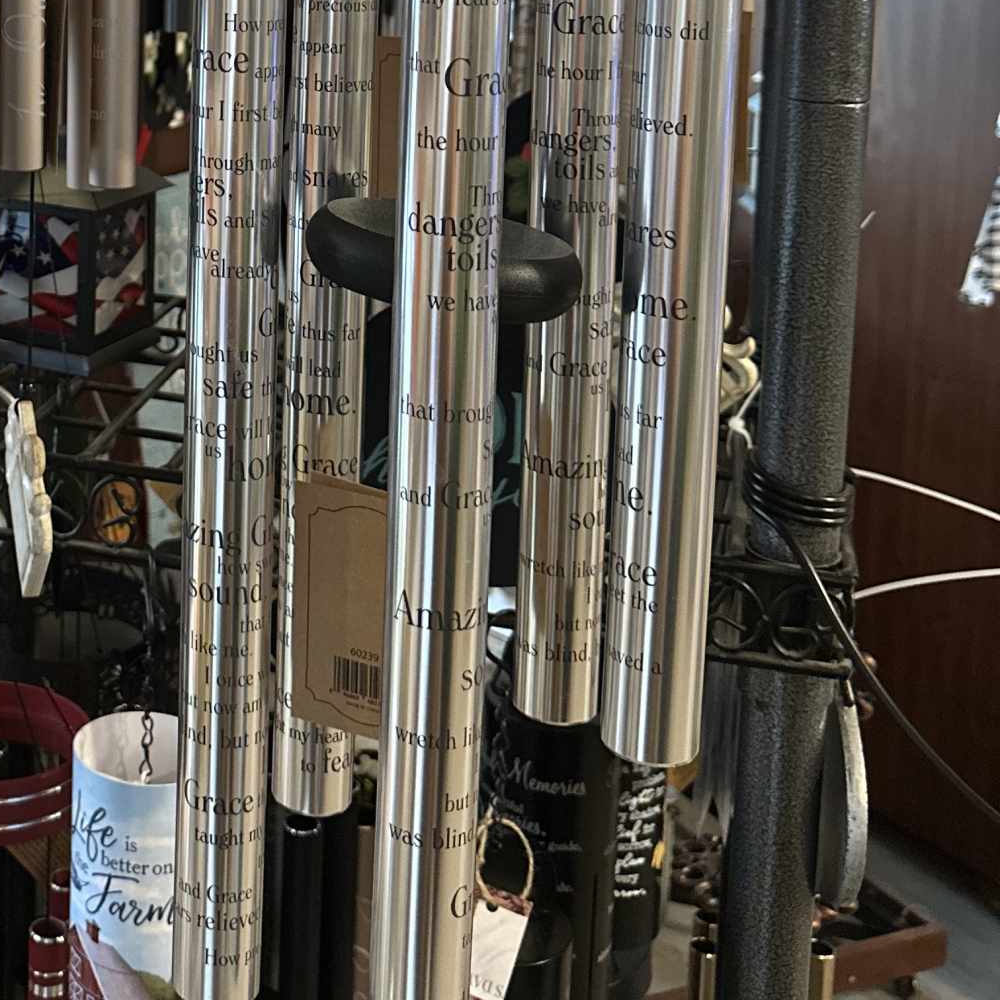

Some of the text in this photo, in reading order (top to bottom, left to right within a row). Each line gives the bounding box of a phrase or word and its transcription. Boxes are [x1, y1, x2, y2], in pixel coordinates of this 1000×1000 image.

[224, 14, 261, 32] How
[680, 21, 709, 40] did
[411, 53, 440, 74] that
[562, 61, 603, 81] hour
[233, 102, 267, 121] first
[302, 122, 341, 139] many
[417, 127, 497, 151] the hour
[554, 155, 605, 181] toils
[568, 196, 606, 215] have
[224, 211, 254, 228] and
[428, 294, 456, 311] we
[302, 322, 334, 342] thus
[309, 360, 341, 379] lead
[550, 351, 608, 378] Grace
[203, 371, 253, 399] safe
[401, 396, 435, 421] that
[637, 404, 663, 430] far
[293, 444, 358, 477] Grace
[400, 485, 431, 507] and
[632, 591, 657, 613] the
[554, 613, 580, 632] but
[217, 676, 254, 689] once
[221, 728, 249, 749] but
[289, 730, 306, 745] my
[395, 726, 456, 750] wretch
[301, 759, 315, 774] to
[507, 758, 585, 795] Memories
[184, 778, 254, 815] Grace
[445, 794, 470, 813] but
[72, 790, 137, 862] Life is
[389, 824, 423, 848] was
[195, 828, 244, 850] taught
[101, 851, 173, 876] better on
[86, 872, 174, 926] Farm
[207, 884, 253, 904] Grace
[204, 948, 239, 967] How
